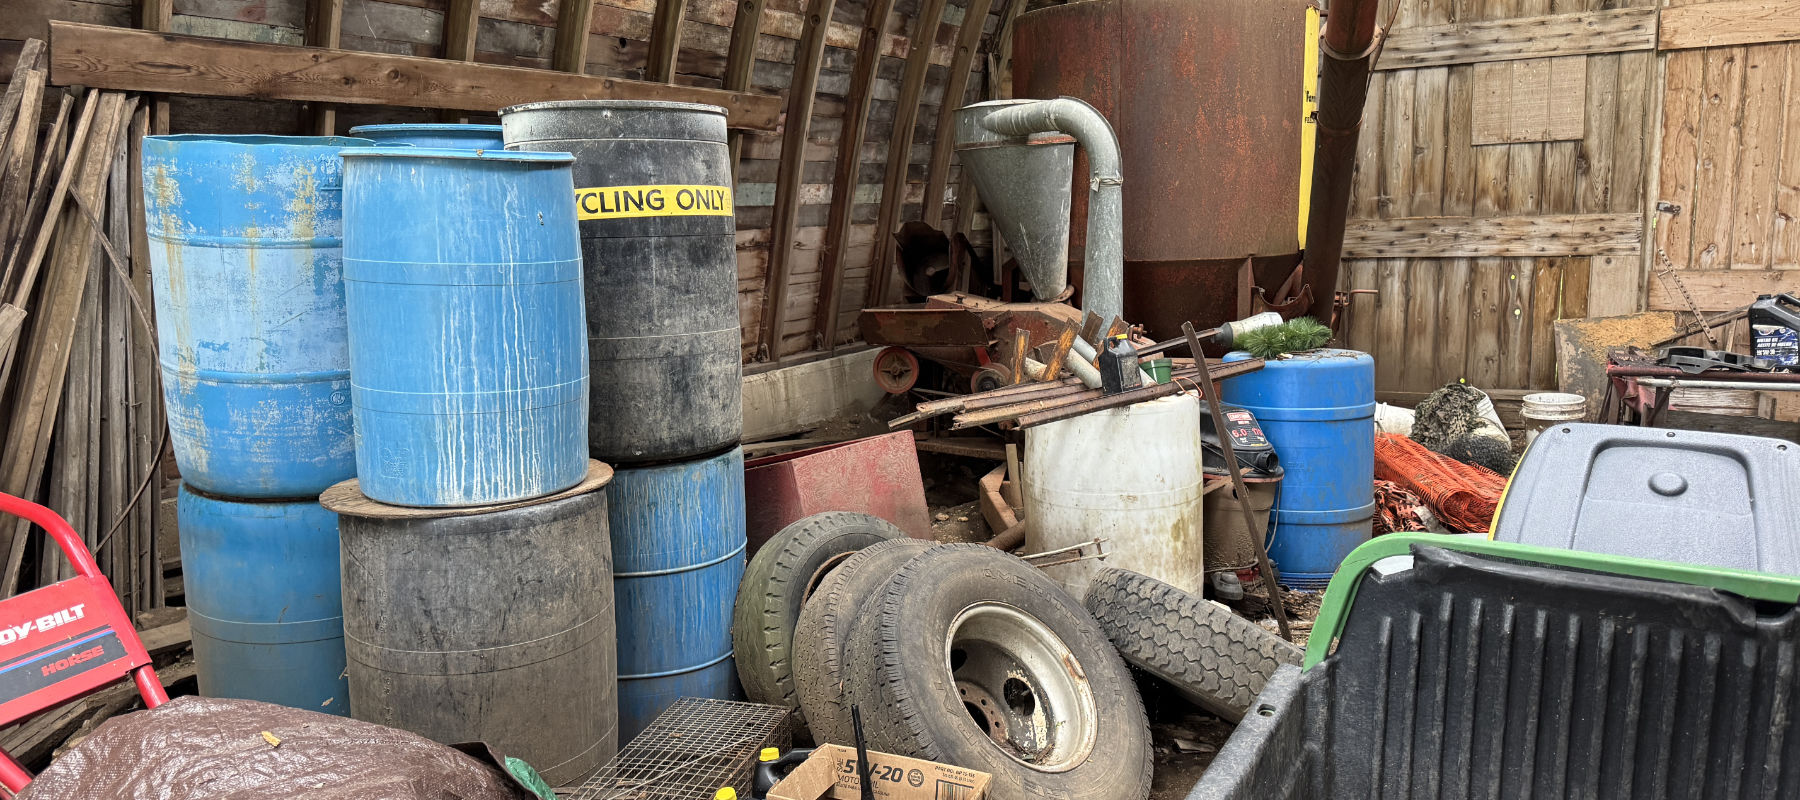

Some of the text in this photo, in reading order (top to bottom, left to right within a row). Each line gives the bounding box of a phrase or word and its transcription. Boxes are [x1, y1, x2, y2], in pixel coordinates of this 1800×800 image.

[676, 188, 725, 211] ONLY
[0, 603, 85, 645] OY-BILT
[41, 645, 105, 677] HORSE
[837, 774, 860, 785] MOTO
